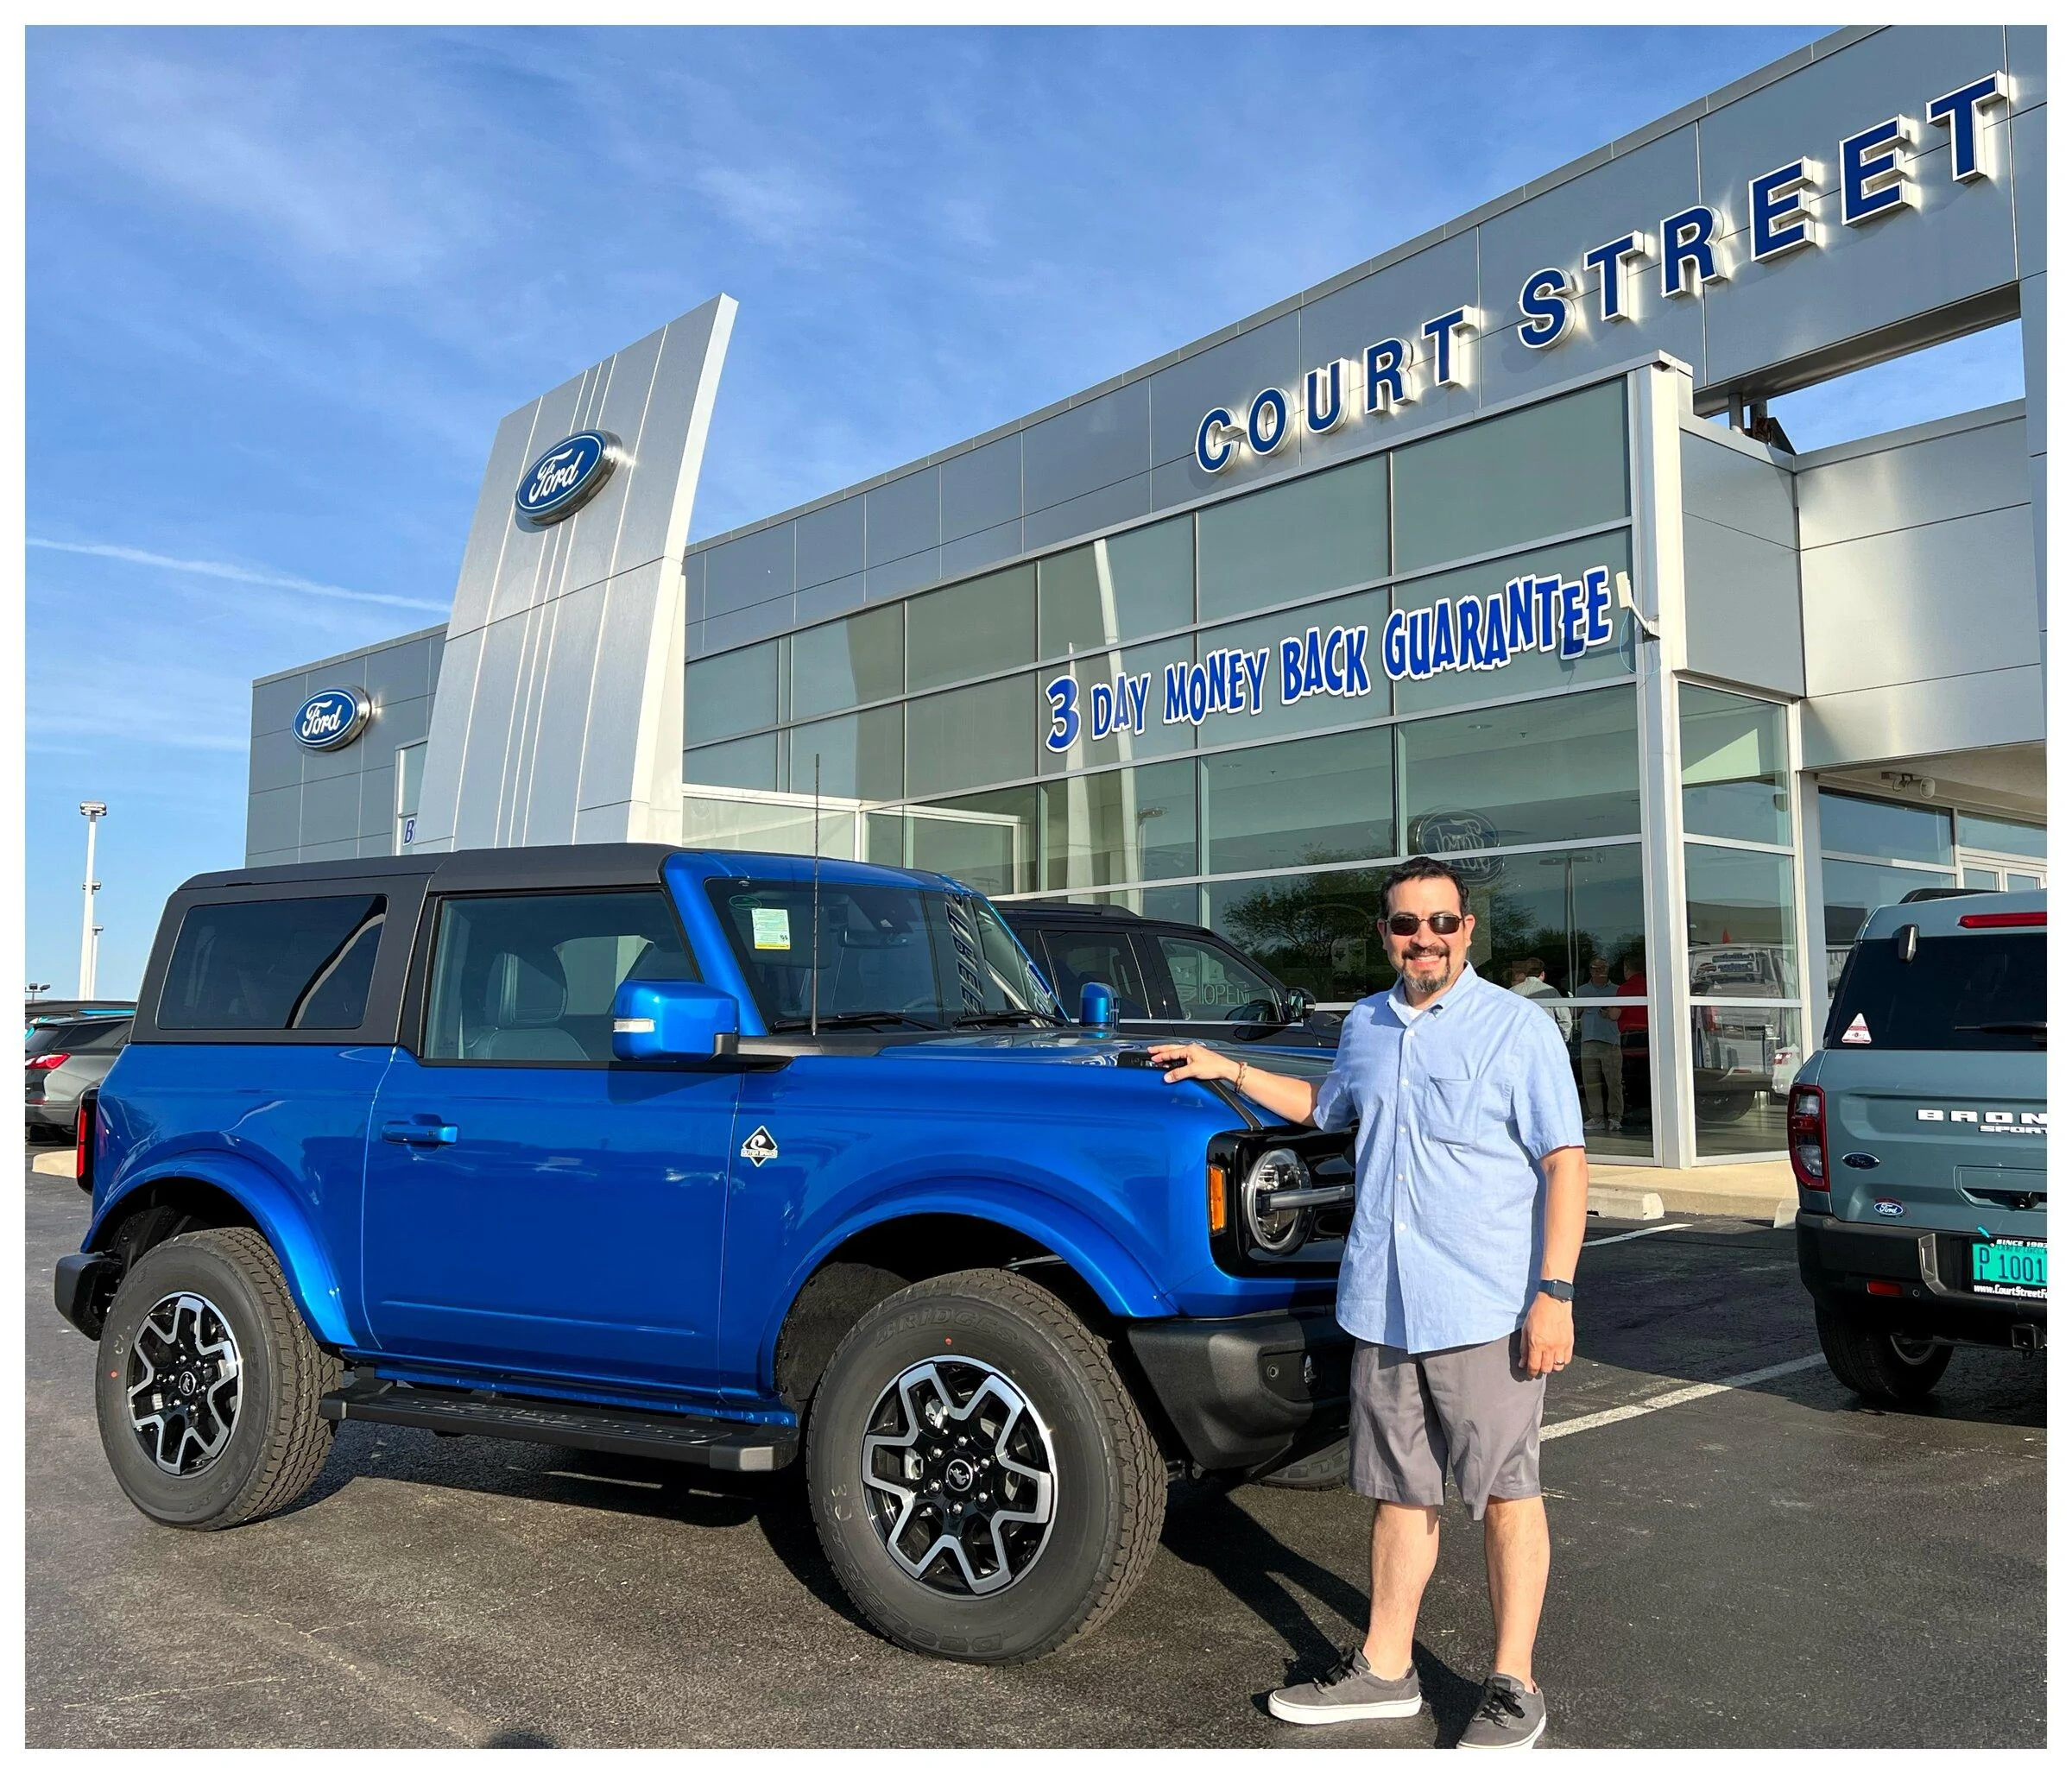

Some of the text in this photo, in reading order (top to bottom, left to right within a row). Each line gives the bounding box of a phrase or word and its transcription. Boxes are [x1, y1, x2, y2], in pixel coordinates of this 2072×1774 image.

[1195, 70, 2008, 473] COURT STREET
[528, 449, 584, 504] Ford
[302, 699, 342, 736] Ford
[1045, 565, 1612, 752] 3 DAY MONEY BACK GUARANTEE
